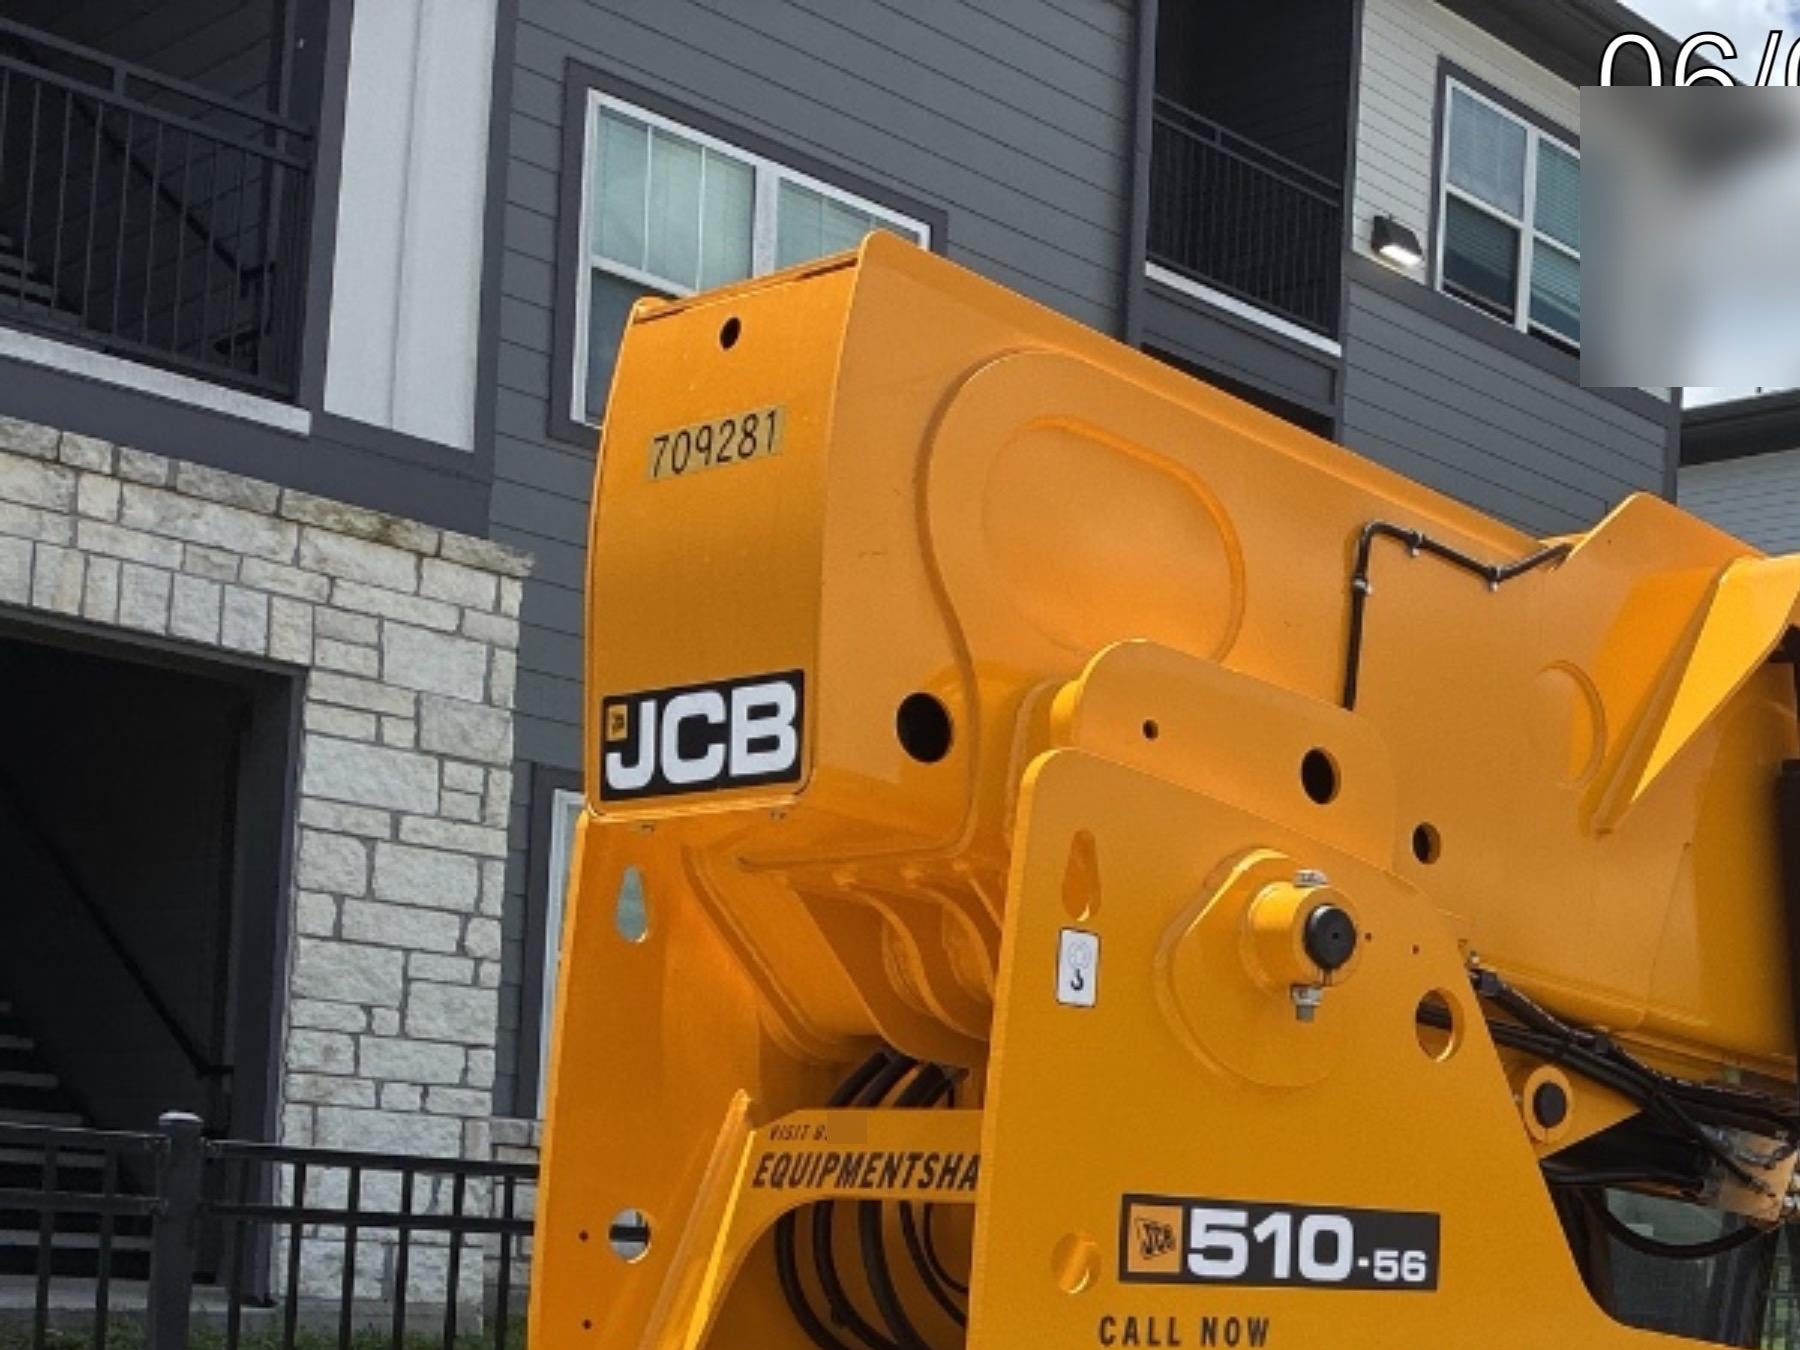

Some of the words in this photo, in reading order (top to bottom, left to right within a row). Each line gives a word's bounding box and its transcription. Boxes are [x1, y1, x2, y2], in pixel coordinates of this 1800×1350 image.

[652, 409, 779, 478] 709281
[605, 681, 797, 790] JCB
[1099, 1315, 1182, 1348] CALL
[1200, 1316, 1271, 1348] NOW
